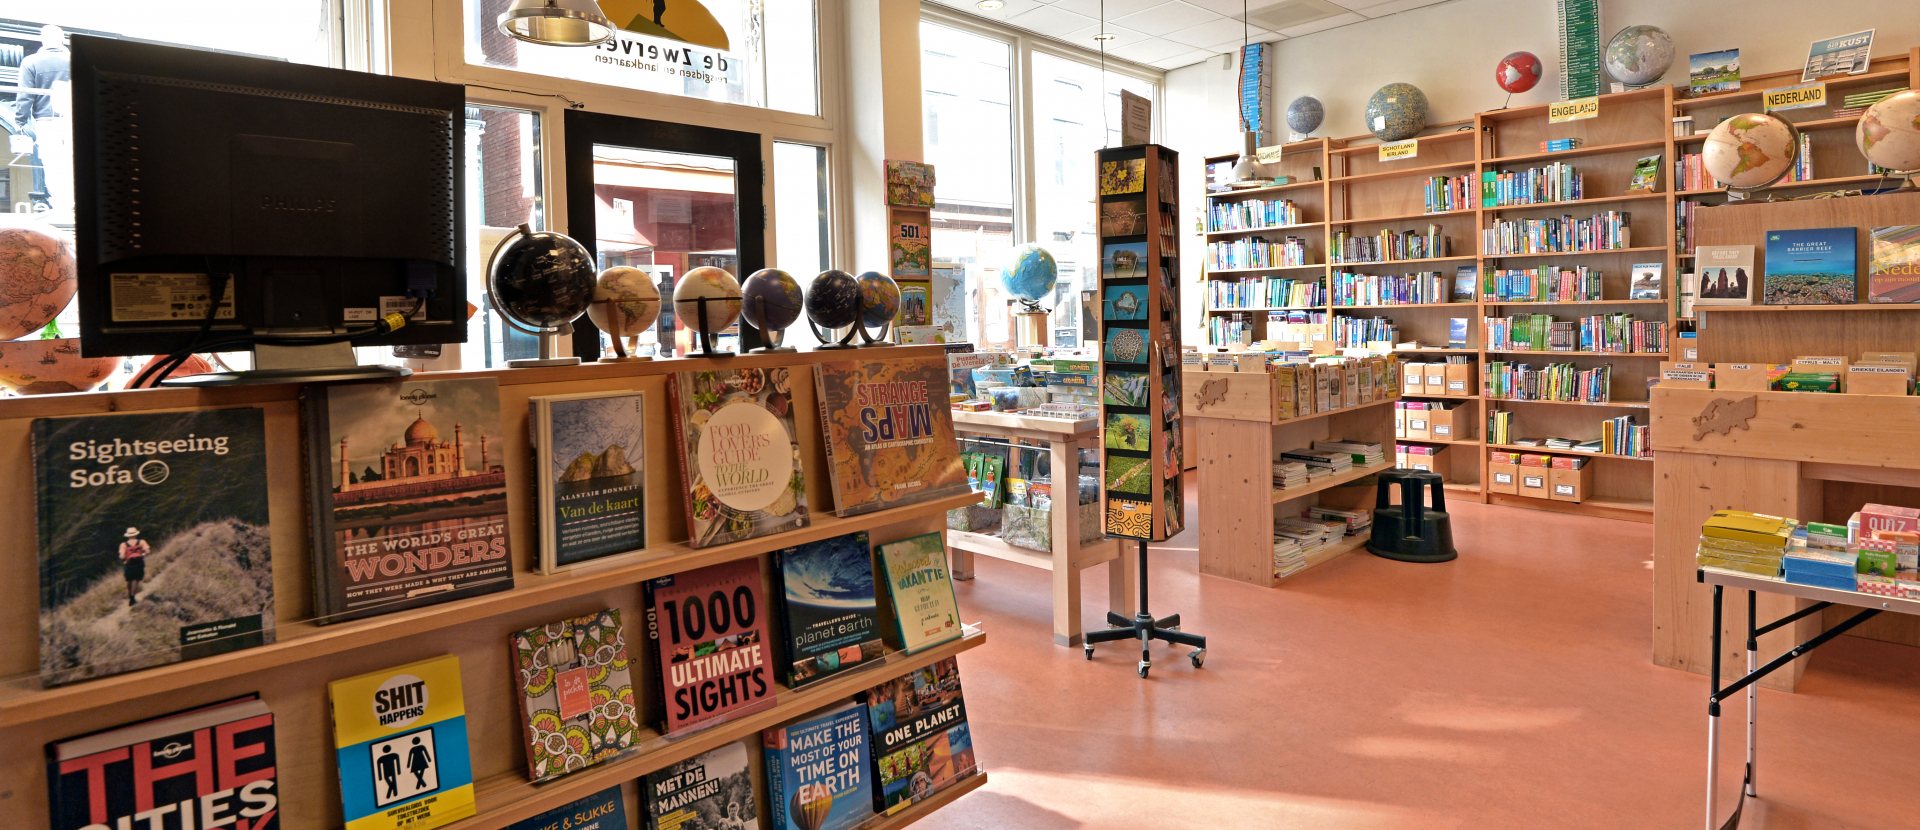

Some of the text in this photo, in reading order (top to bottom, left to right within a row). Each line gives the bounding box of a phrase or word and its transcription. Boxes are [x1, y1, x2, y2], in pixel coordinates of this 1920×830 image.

[1551, 101, 1597, 118] ENGELAND
[1768, 88, 1822, 106] NEDERLAND
[901, 225, 920, 239] 501
[857, 380, 929, 406] STRANGE
[710, 423, 751, 438] FOOD
[860, 403, 934, 444] MAPS
[69, 433, 230, 464] Sightseeing
[713, 447, 761, 465] GUIDE
[70, 465, 134, 488] Sofa
[561, 484, 638, 501] ALASTAIR BONNETT
[716, 468, 769, 487] WORLD
[560, 497, 639, 519] Van de kaart
[345, 524, 505, 557] THE WORLD'S GREAT
[1869, 517, 1906, 533] QUIZ
[345, 537, 507, 583] WONDERS
[347, 590, 363, 598] HOW
[365, 586, 383, 596] THEY
[405, 580, 424, 588] MADE
[432, 576, 447, 584] WHY
[448, 573, 464, 581] THEY
[646, 606, 659, 640] 1000
[664, 585, 756, 645] 1000
[795, 625, 836, 649] planet
[838, 616, 873, 635] earth
[671, 644, 763, 688] ULTIMATE
[375, 680, 425, 714] SHIT
[674, 667, 767, 721] SIGHTS
[379, 705, 425, 726] HAPPENS
[885, 723, 912, 746] ONE
[915, 703, 960, 734] PLANET
[791, 728, 833, 753] MAKE
[835, 718, 861, 739] THE
[791, 734, 862, 767] MOST OF YOUR
[59, 712, 277, 826] THE
[656, 767, 704, 797] MET DE
[796, 748, 859, 784] TIME ON
[658, 779, 719, 814] MANNEN!
[799, 765, 860, 805] EARTH
[574, 800, 616, 826] SUKKE
